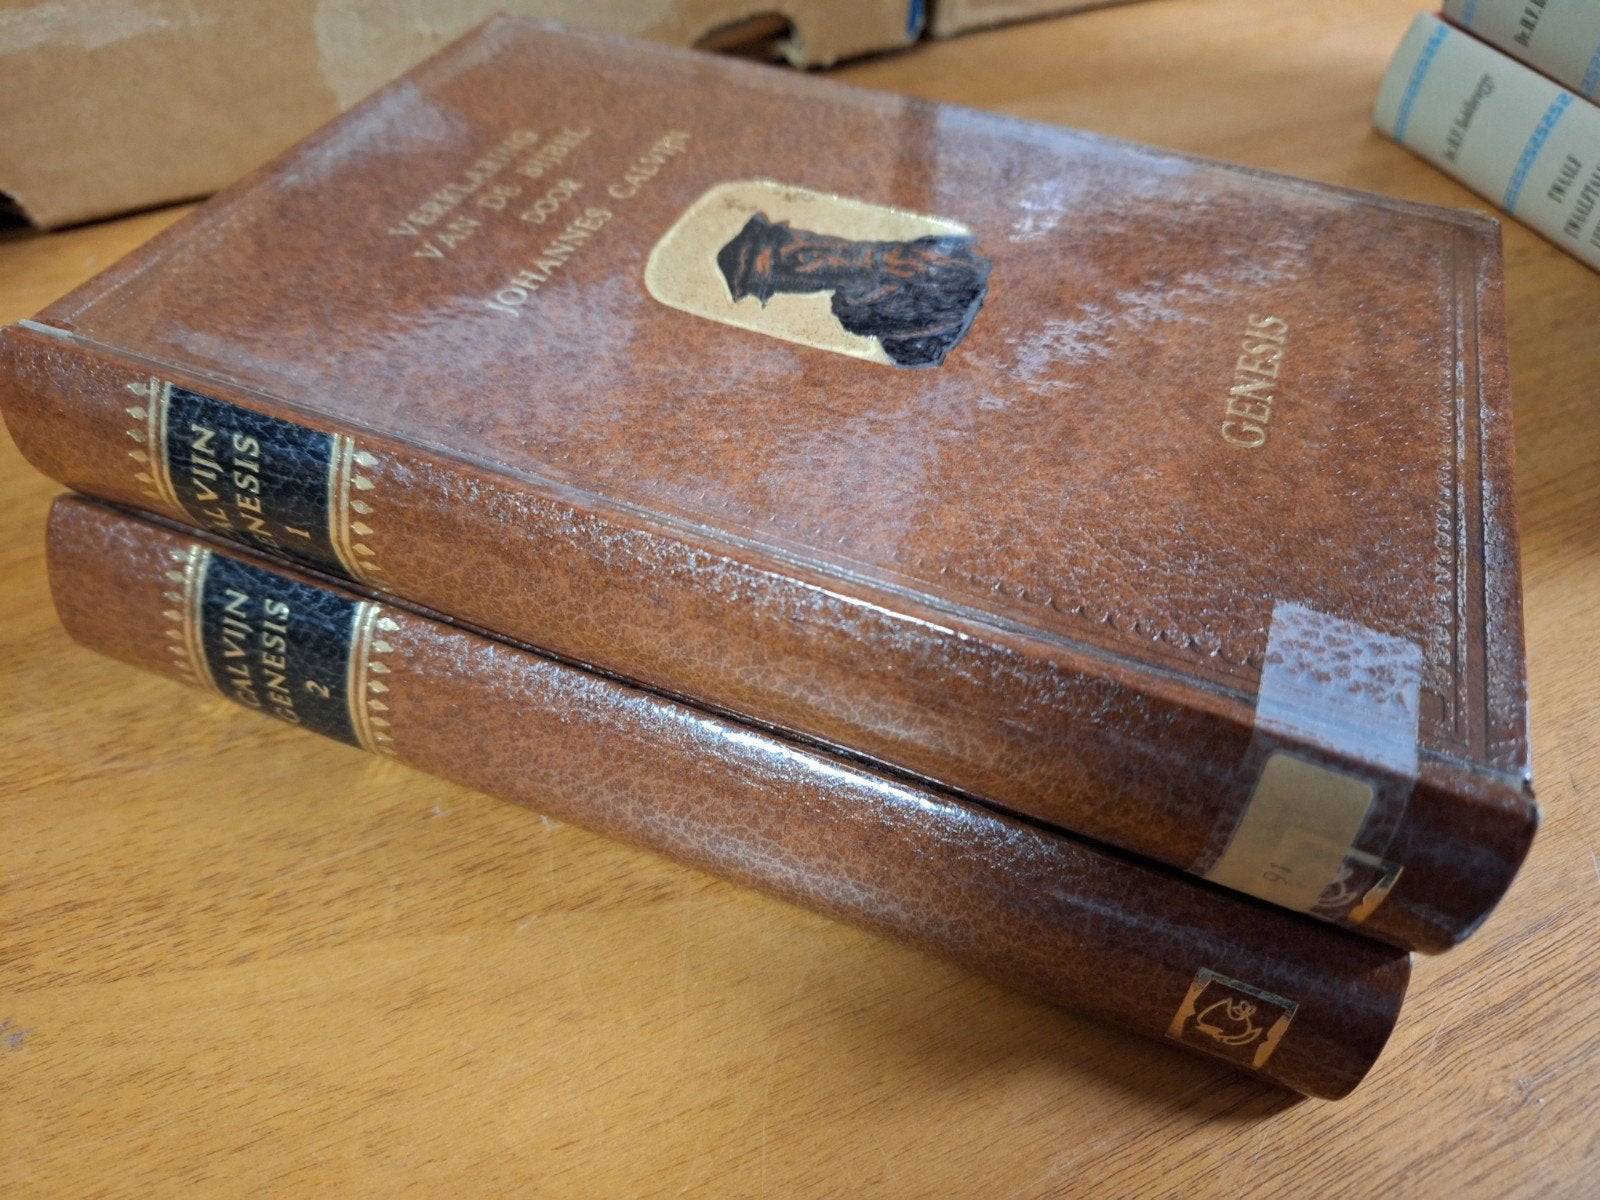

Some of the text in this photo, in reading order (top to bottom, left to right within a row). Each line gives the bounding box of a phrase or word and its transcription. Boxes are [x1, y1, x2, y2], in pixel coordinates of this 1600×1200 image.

[413, 214, 482, 259] VAN
[477, 183, 523, 213] DE
[520, 178, 584, 224] DOOR
[486, 206, 612, 317] JOHANNES
[1221, 313, 1289, 449] GENESIS
[284, 525, 311, 540] 1
[223, 588, 262, 707] CALVIJN
[261, 598, 300, 724] GENESIS
[306, 679, 331, 699] 2
